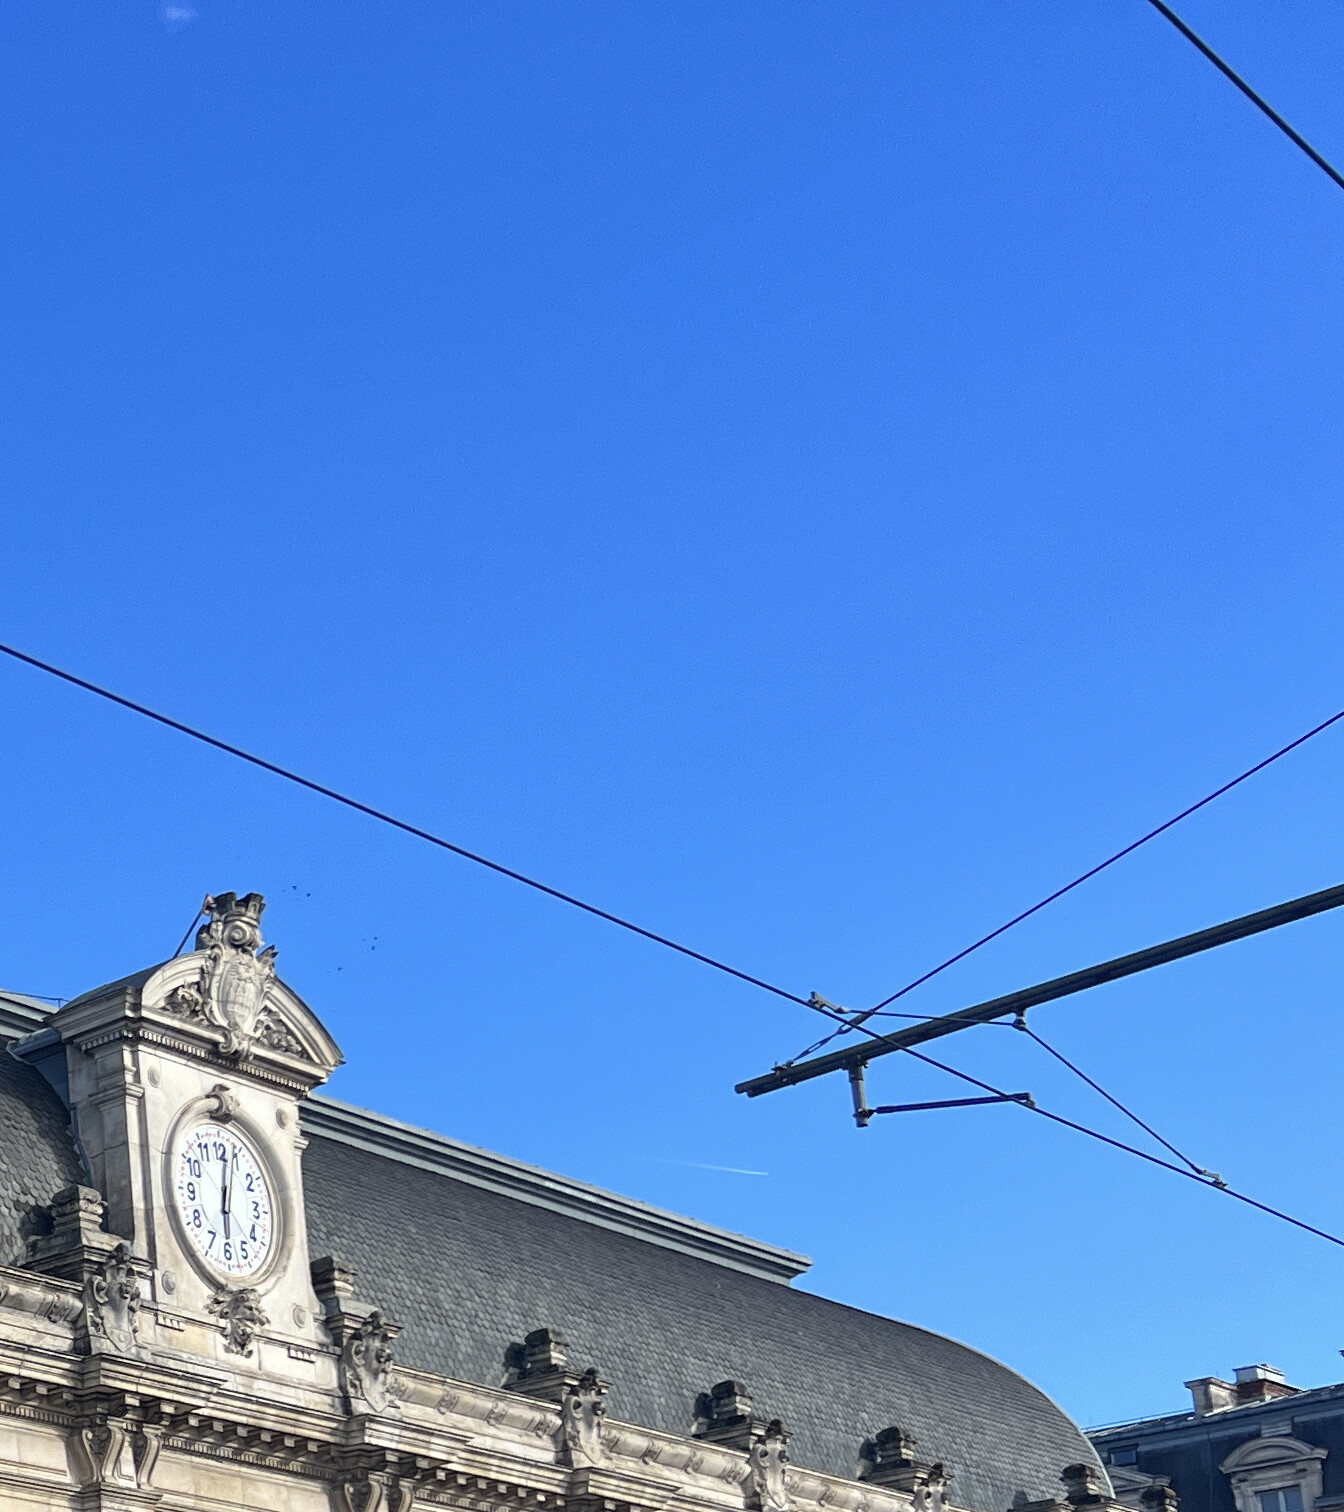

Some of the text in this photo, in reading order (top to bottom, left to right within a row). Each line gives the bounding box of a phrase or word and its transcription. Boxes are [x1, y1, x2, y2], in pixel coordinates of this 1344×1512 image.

[197, 1142, 210, 1162] 11
[213, 1141, 228, 1162] 12
[186, 1157, 202, 1178] 10
[233, 1152, 239, 1171] 1
[187, 1182, 196, 1201] 9
[245, 1173, 255, 1192] 2
[193, 1209, 202, 1228] 8
[252, 1201, 260, 1219] 3
[208, 1230, 216, 1249] 7
[250, 1224, 257, 1242] 4
[224, 1241, 232, 1261] 6
[240, 1240, 248, 1260] 5
